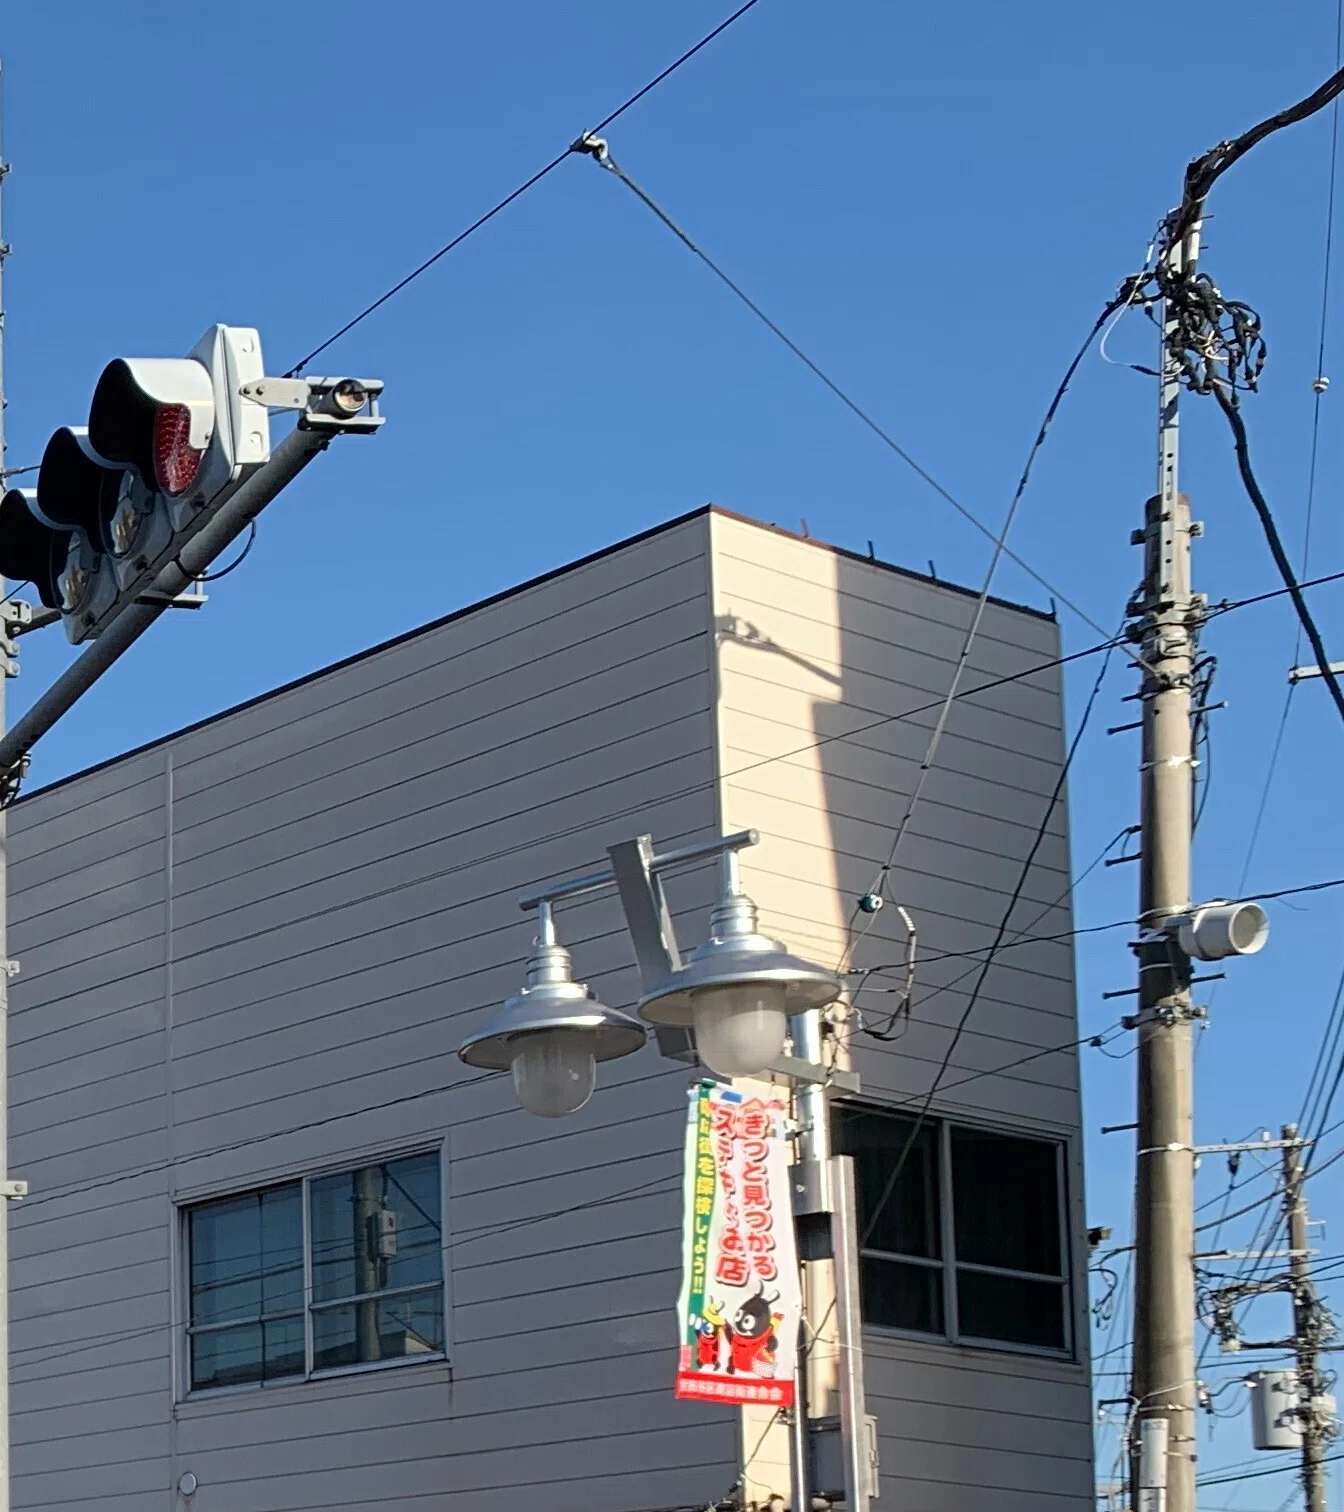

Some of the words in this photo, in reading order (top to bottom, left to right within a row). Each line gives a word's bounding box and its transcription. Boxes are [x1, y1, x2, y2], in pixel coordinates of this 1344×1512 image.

[742, 1112, 776, 1279] きっと見つかる
